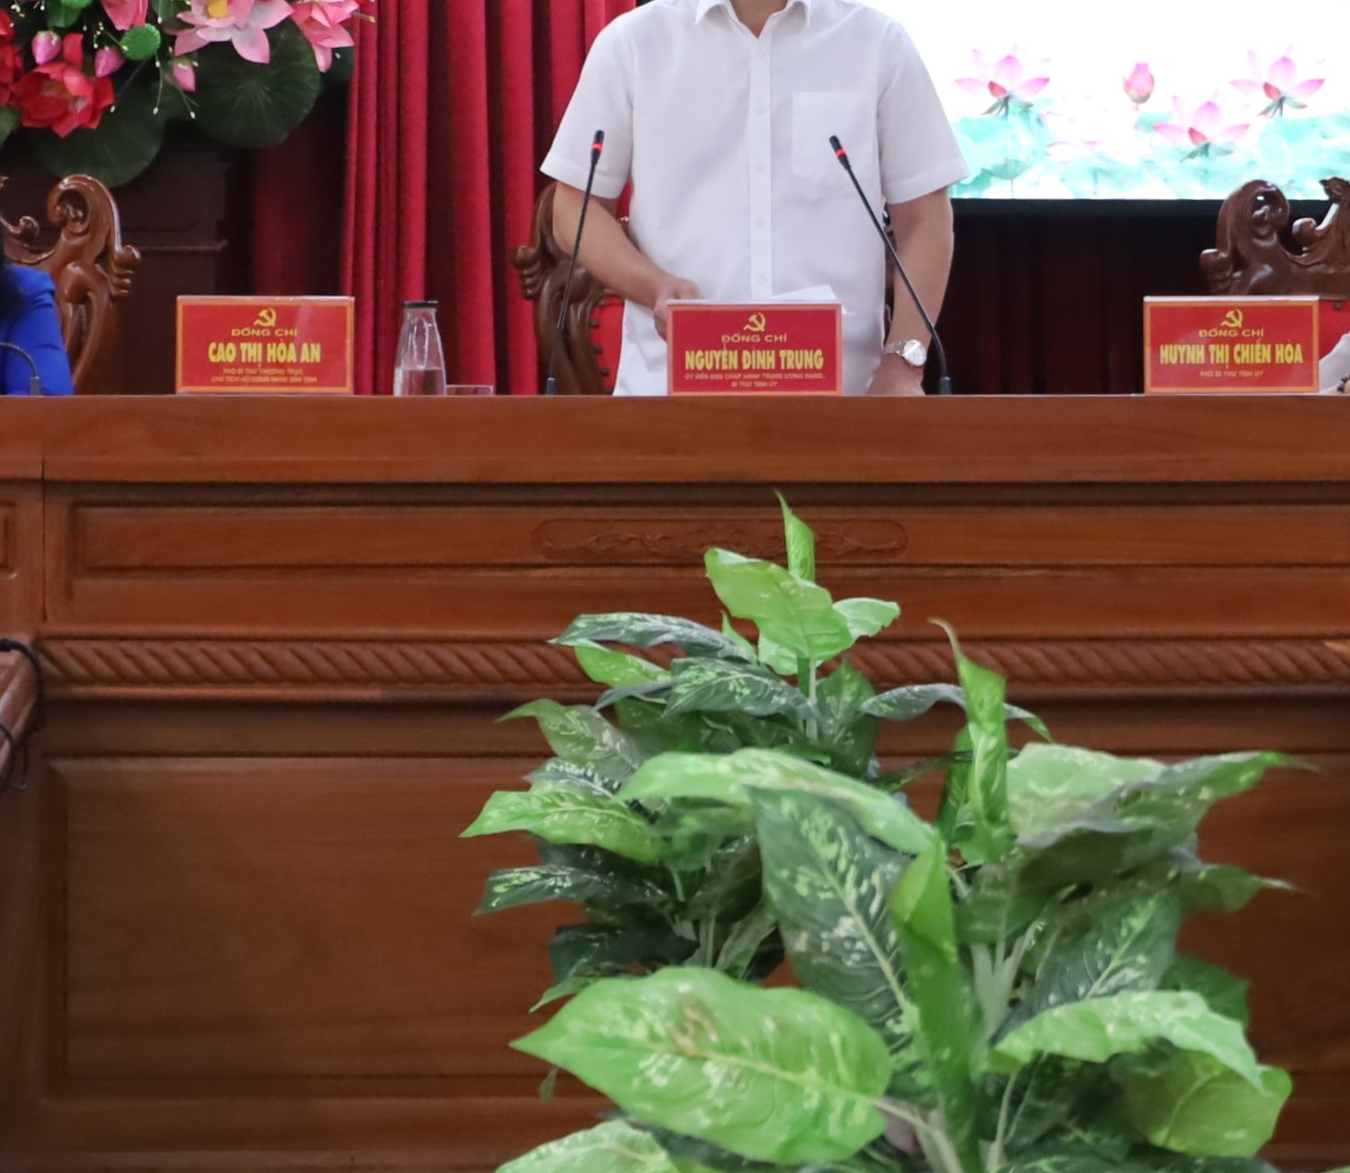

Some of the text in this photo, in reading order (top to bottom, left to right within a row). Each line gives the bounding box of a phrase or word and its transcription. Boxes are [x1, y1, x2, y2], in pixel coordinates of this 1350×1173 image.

[208, 341, 237, 363] CAO
[240, 342, 263, 368] THỊ
[300, 342, 321, 363] AN
[741, 347, 775, 370] ĐÌNH
[779, 349, 824, 370] TRUNG
[1160, 338, 1303, 369] HUỲNH THỊ CHIẾN HÒA
